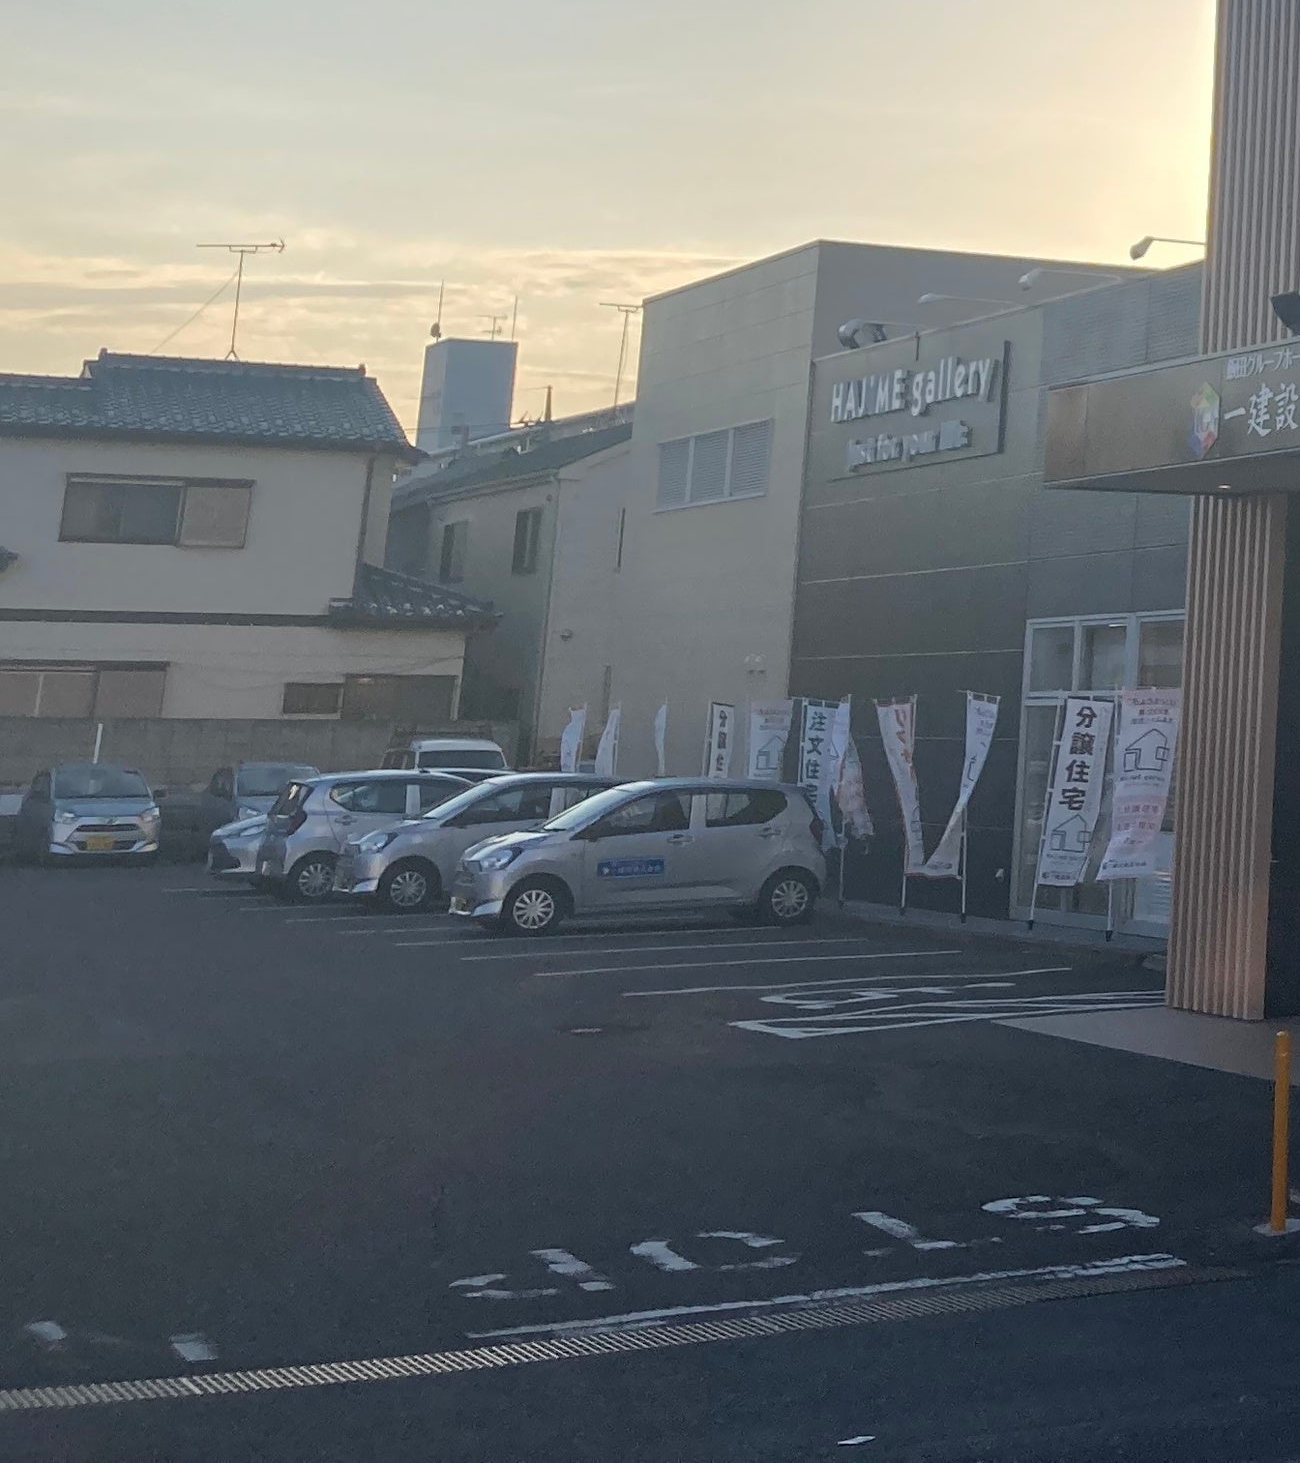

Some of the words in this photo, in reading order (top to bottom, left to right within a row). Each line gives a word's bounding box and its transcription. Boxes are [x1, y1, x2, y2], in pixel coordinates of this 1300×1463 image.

[910, 355, 991, 418] gallery
[1058, 705, 1098, 811] 分譲住宅
